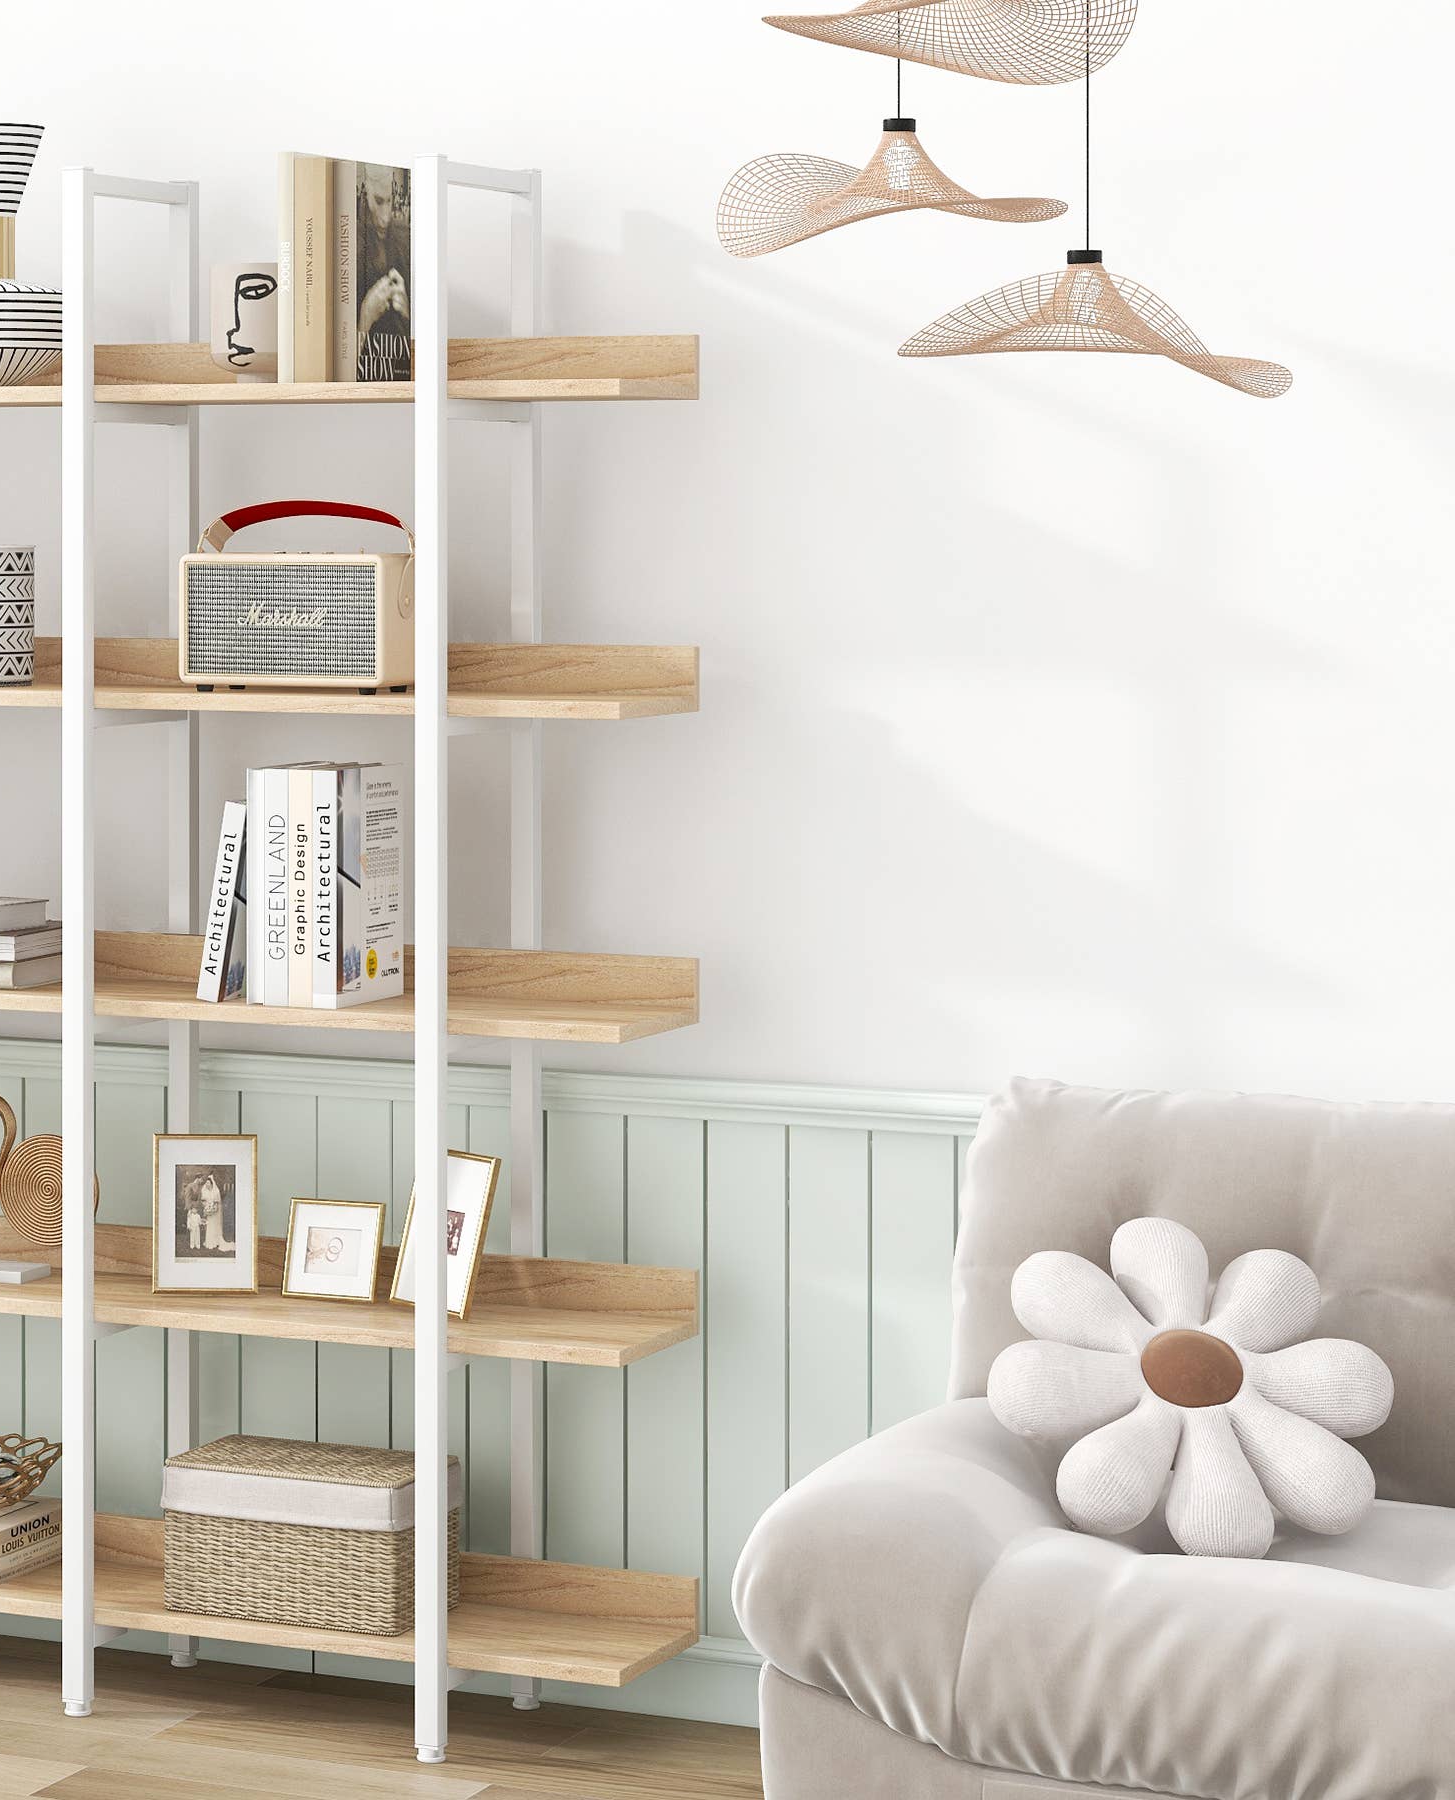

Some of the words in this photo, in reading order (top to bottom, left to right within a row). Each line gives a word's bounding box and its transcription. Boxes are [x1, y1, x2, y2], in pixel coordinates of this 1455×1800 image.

[305, 217, 313, 258] YOUSSEF
[340, 215, 350, 266] FASHION
[305, 261, 313, 289] NABIL
[340, 270, 350, 305] SHOW
[357, 331, 411, 360] FASHION
[357, 355, 396, 381] SHOW
[237, 601, 327, 627] Marshall
[294, 824, 308, 881] Design
[268, 814, 286, 960] GREENLAND
[317, 803, 331, 962] Architectural
[205, 833, 237, 976] Architectural
[294, 889, 308, 955] Graphic
[1, 1536, 25, 1554] LOUIS
[27, 1523, 60, 1543] VUITTON
[10, 1514, 50, 1538] UNION
